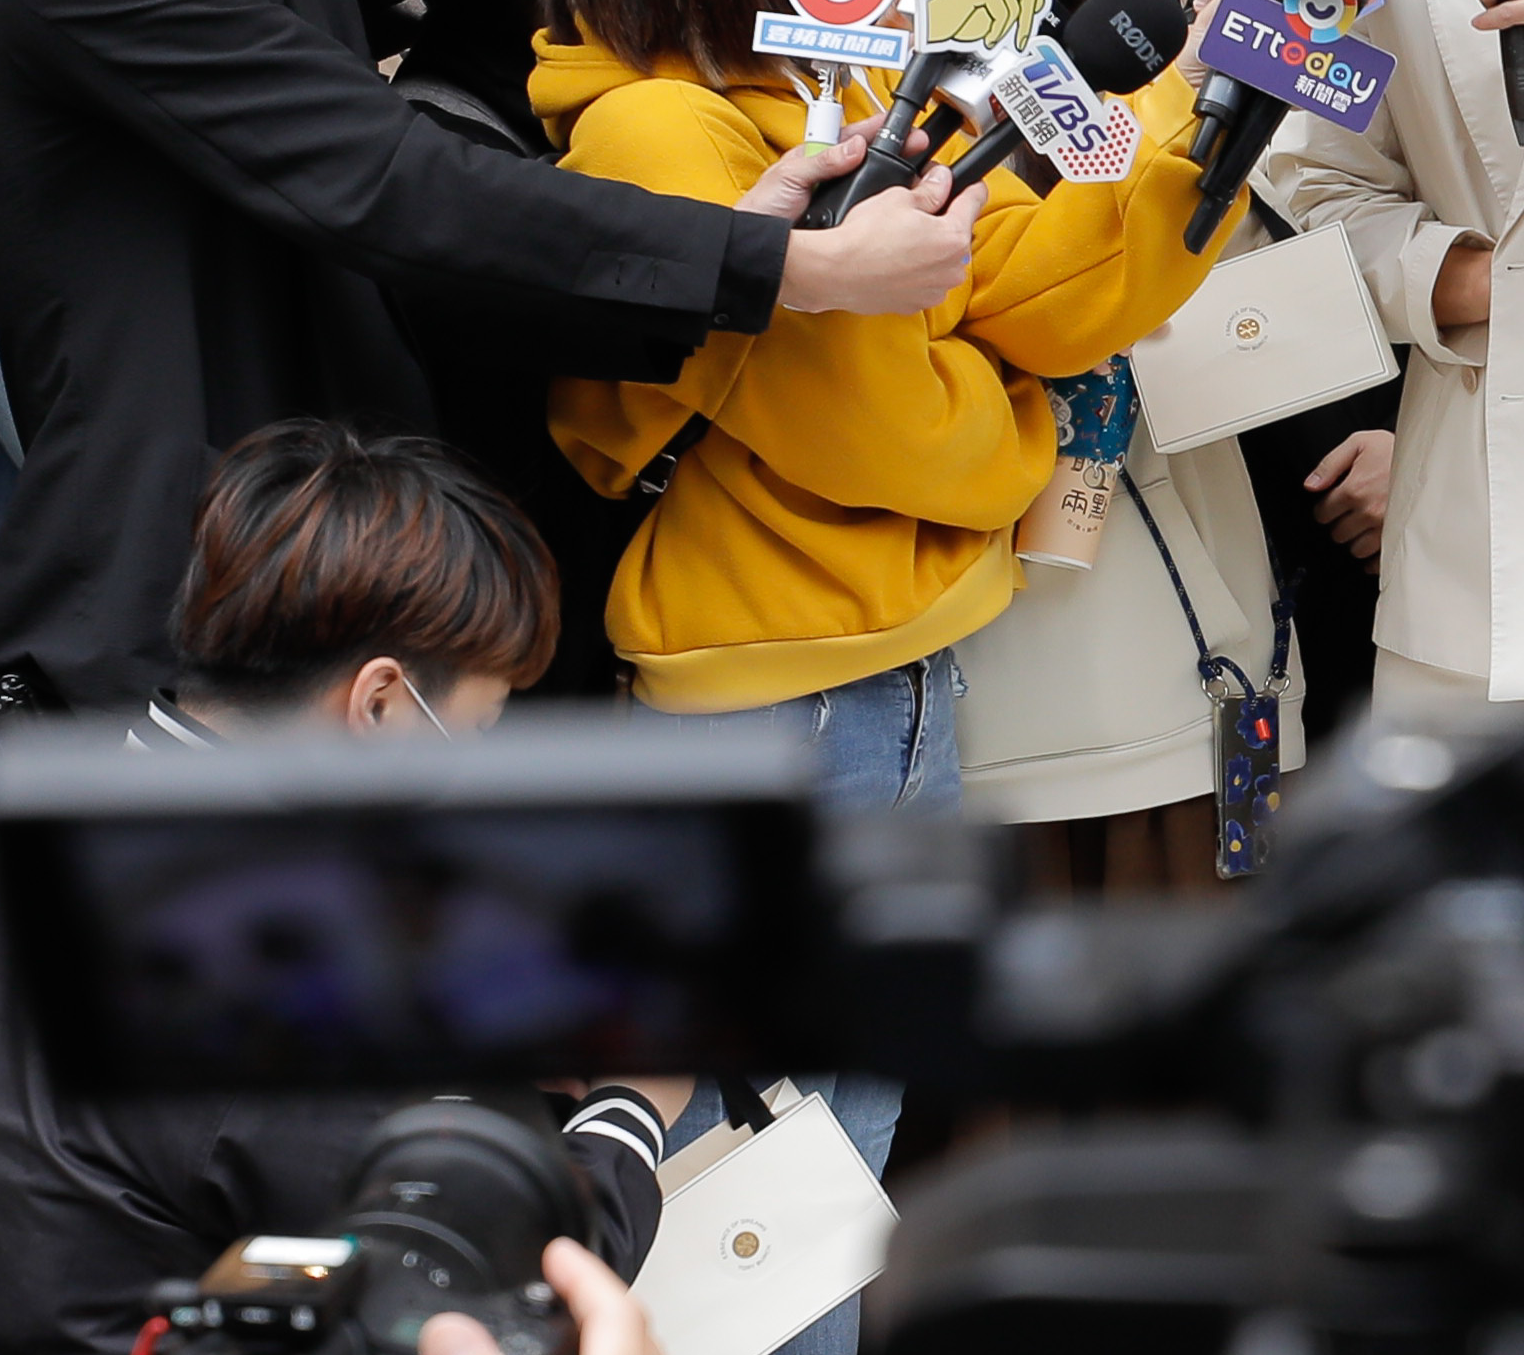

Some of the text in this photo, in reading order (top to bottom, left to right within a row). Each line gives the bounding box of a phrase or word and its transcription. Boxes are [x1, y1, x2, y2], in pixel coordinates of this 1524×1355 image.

[1022, 45, 1109, 153] TVBS
[1221, 10, 1377, 105] ETtoday
[1294, 74, 1353, 114] 新聞雲
[997, 73, 1060, 147] 新聞網
